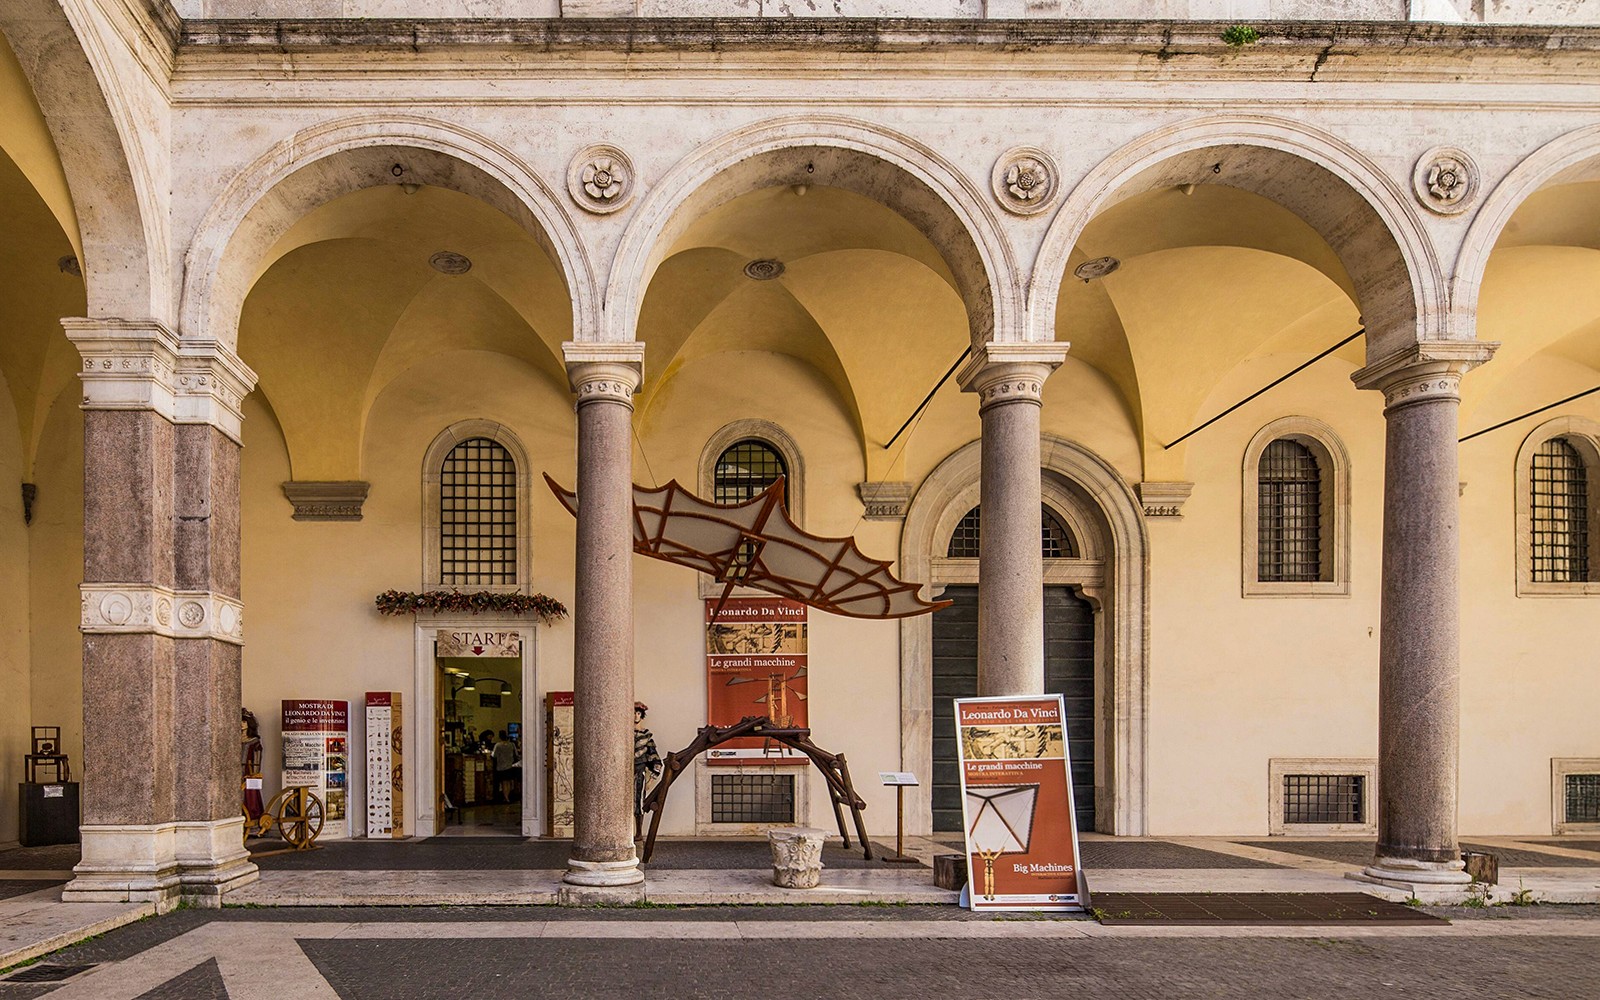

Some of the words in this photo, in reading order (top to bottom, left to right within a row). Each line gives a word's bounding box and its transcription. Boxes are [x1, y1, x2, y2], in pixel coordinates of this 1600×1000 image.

[761, 607, 774, 616] Da
[777, 607, 804, 616] Vinci
[452, 632, 503, 645] START
[723, 658, 752, 668] grandi
[754, 658, 796, 666] macchine
[962, 709, 1011, 720] Leonardo
[1014, 709, 1028, 718] Da
[1030, 708, 1058, 718] Vinci
[978, 762, 1003, 772] grandi
[1013, 864, 1028, 874] Big
[1030, 863, 1073, 872] Machines
